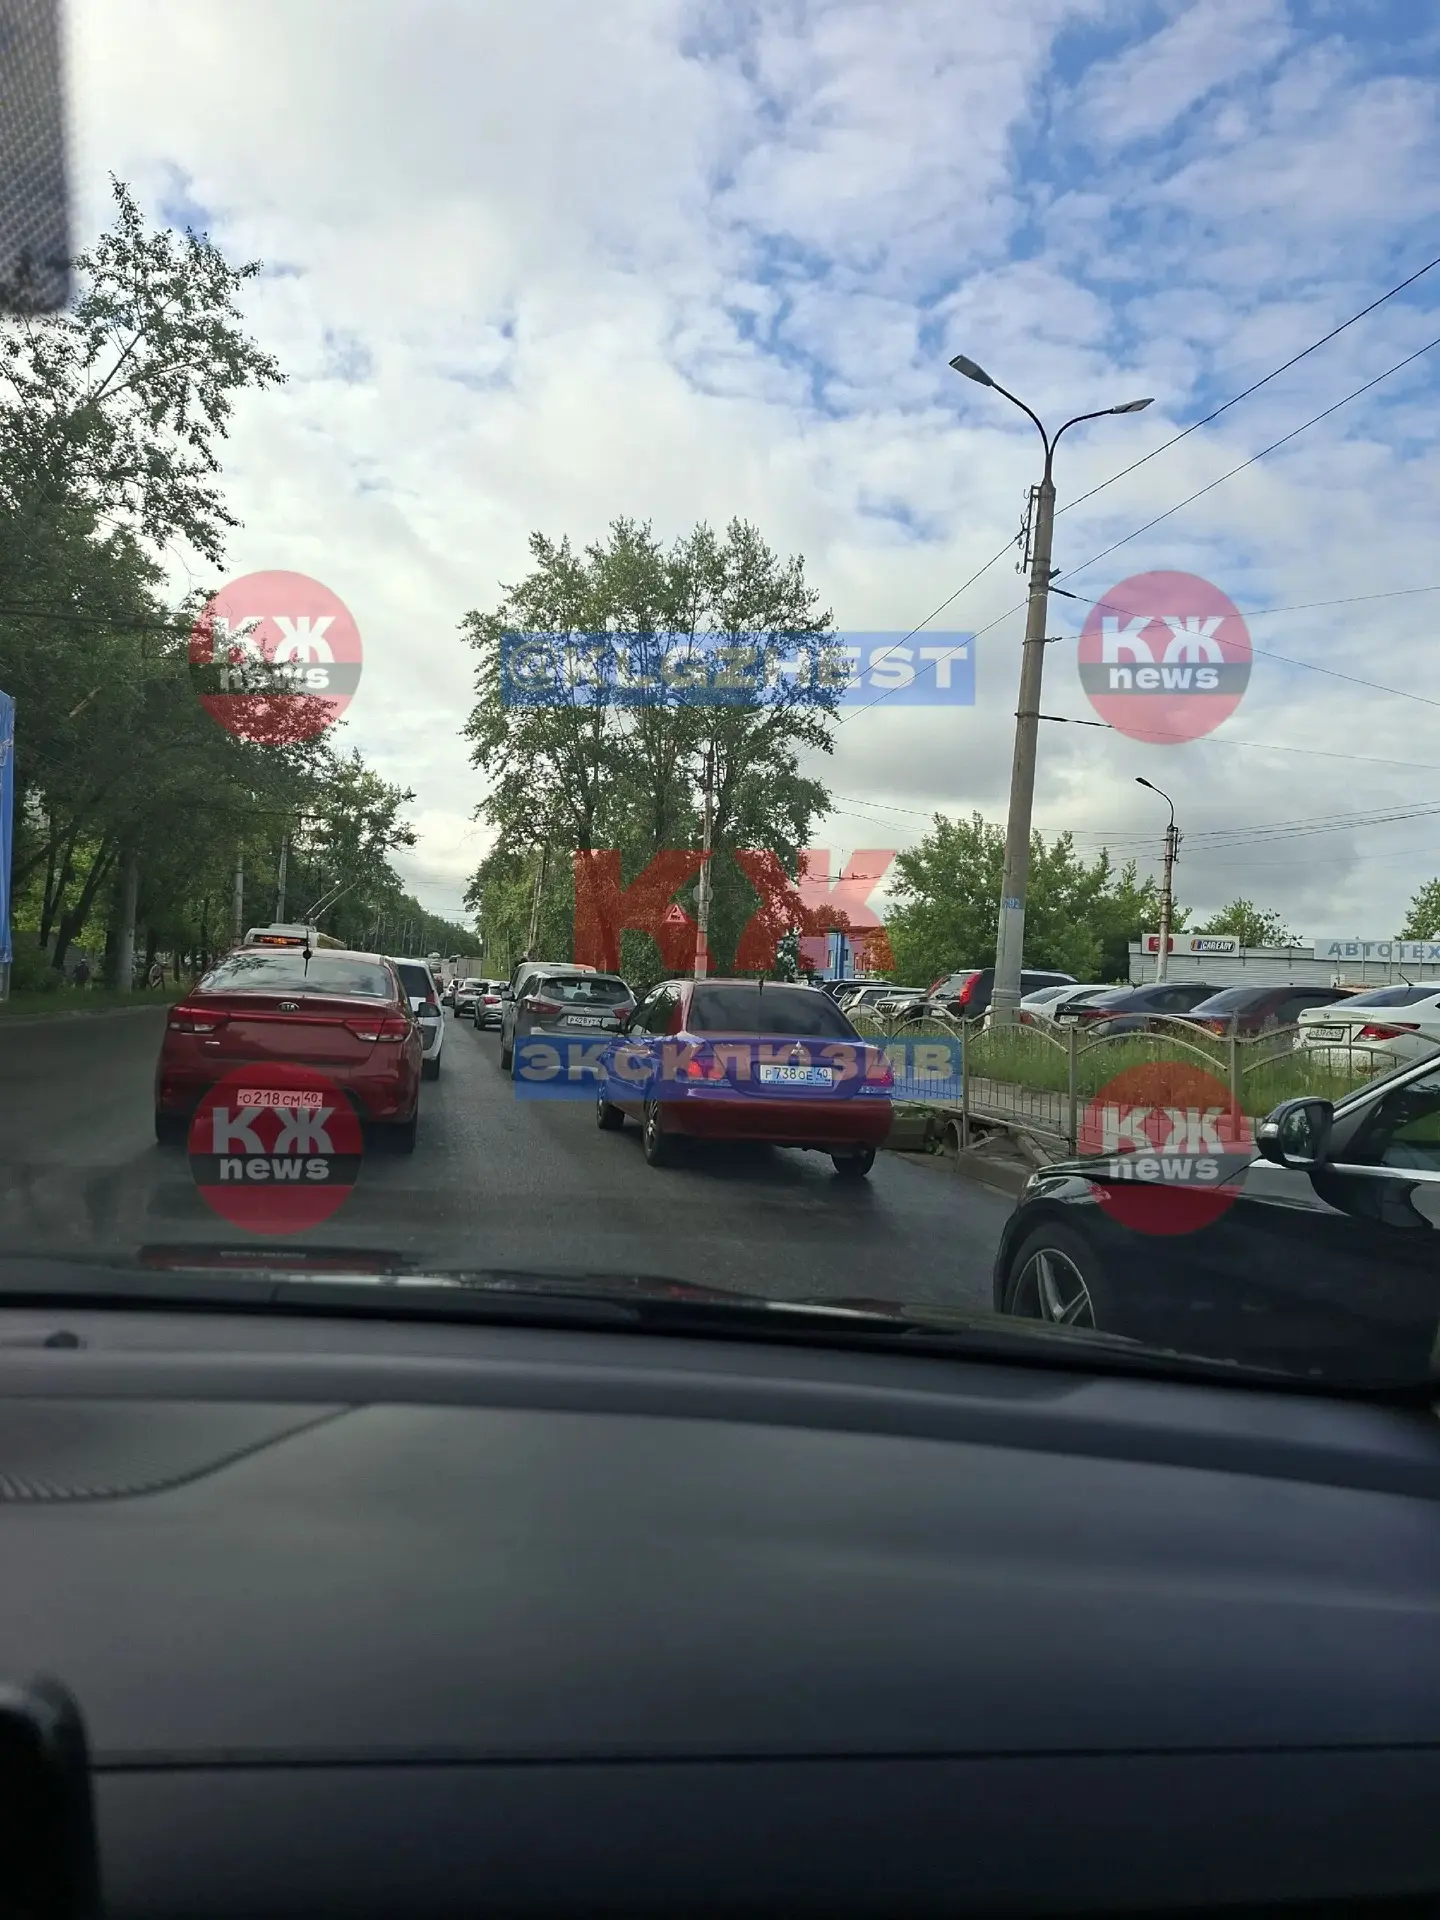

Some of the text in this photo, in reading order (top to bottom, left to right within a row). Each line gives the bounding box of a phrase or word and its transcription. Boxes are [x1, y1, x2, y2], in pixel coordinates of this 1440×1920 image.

[1327, 941, 1440, 959] АВТОТЕХ
[816, 1068, 828, 1079] 40
[242, 1091, 318, 1107] О218СМ 40
